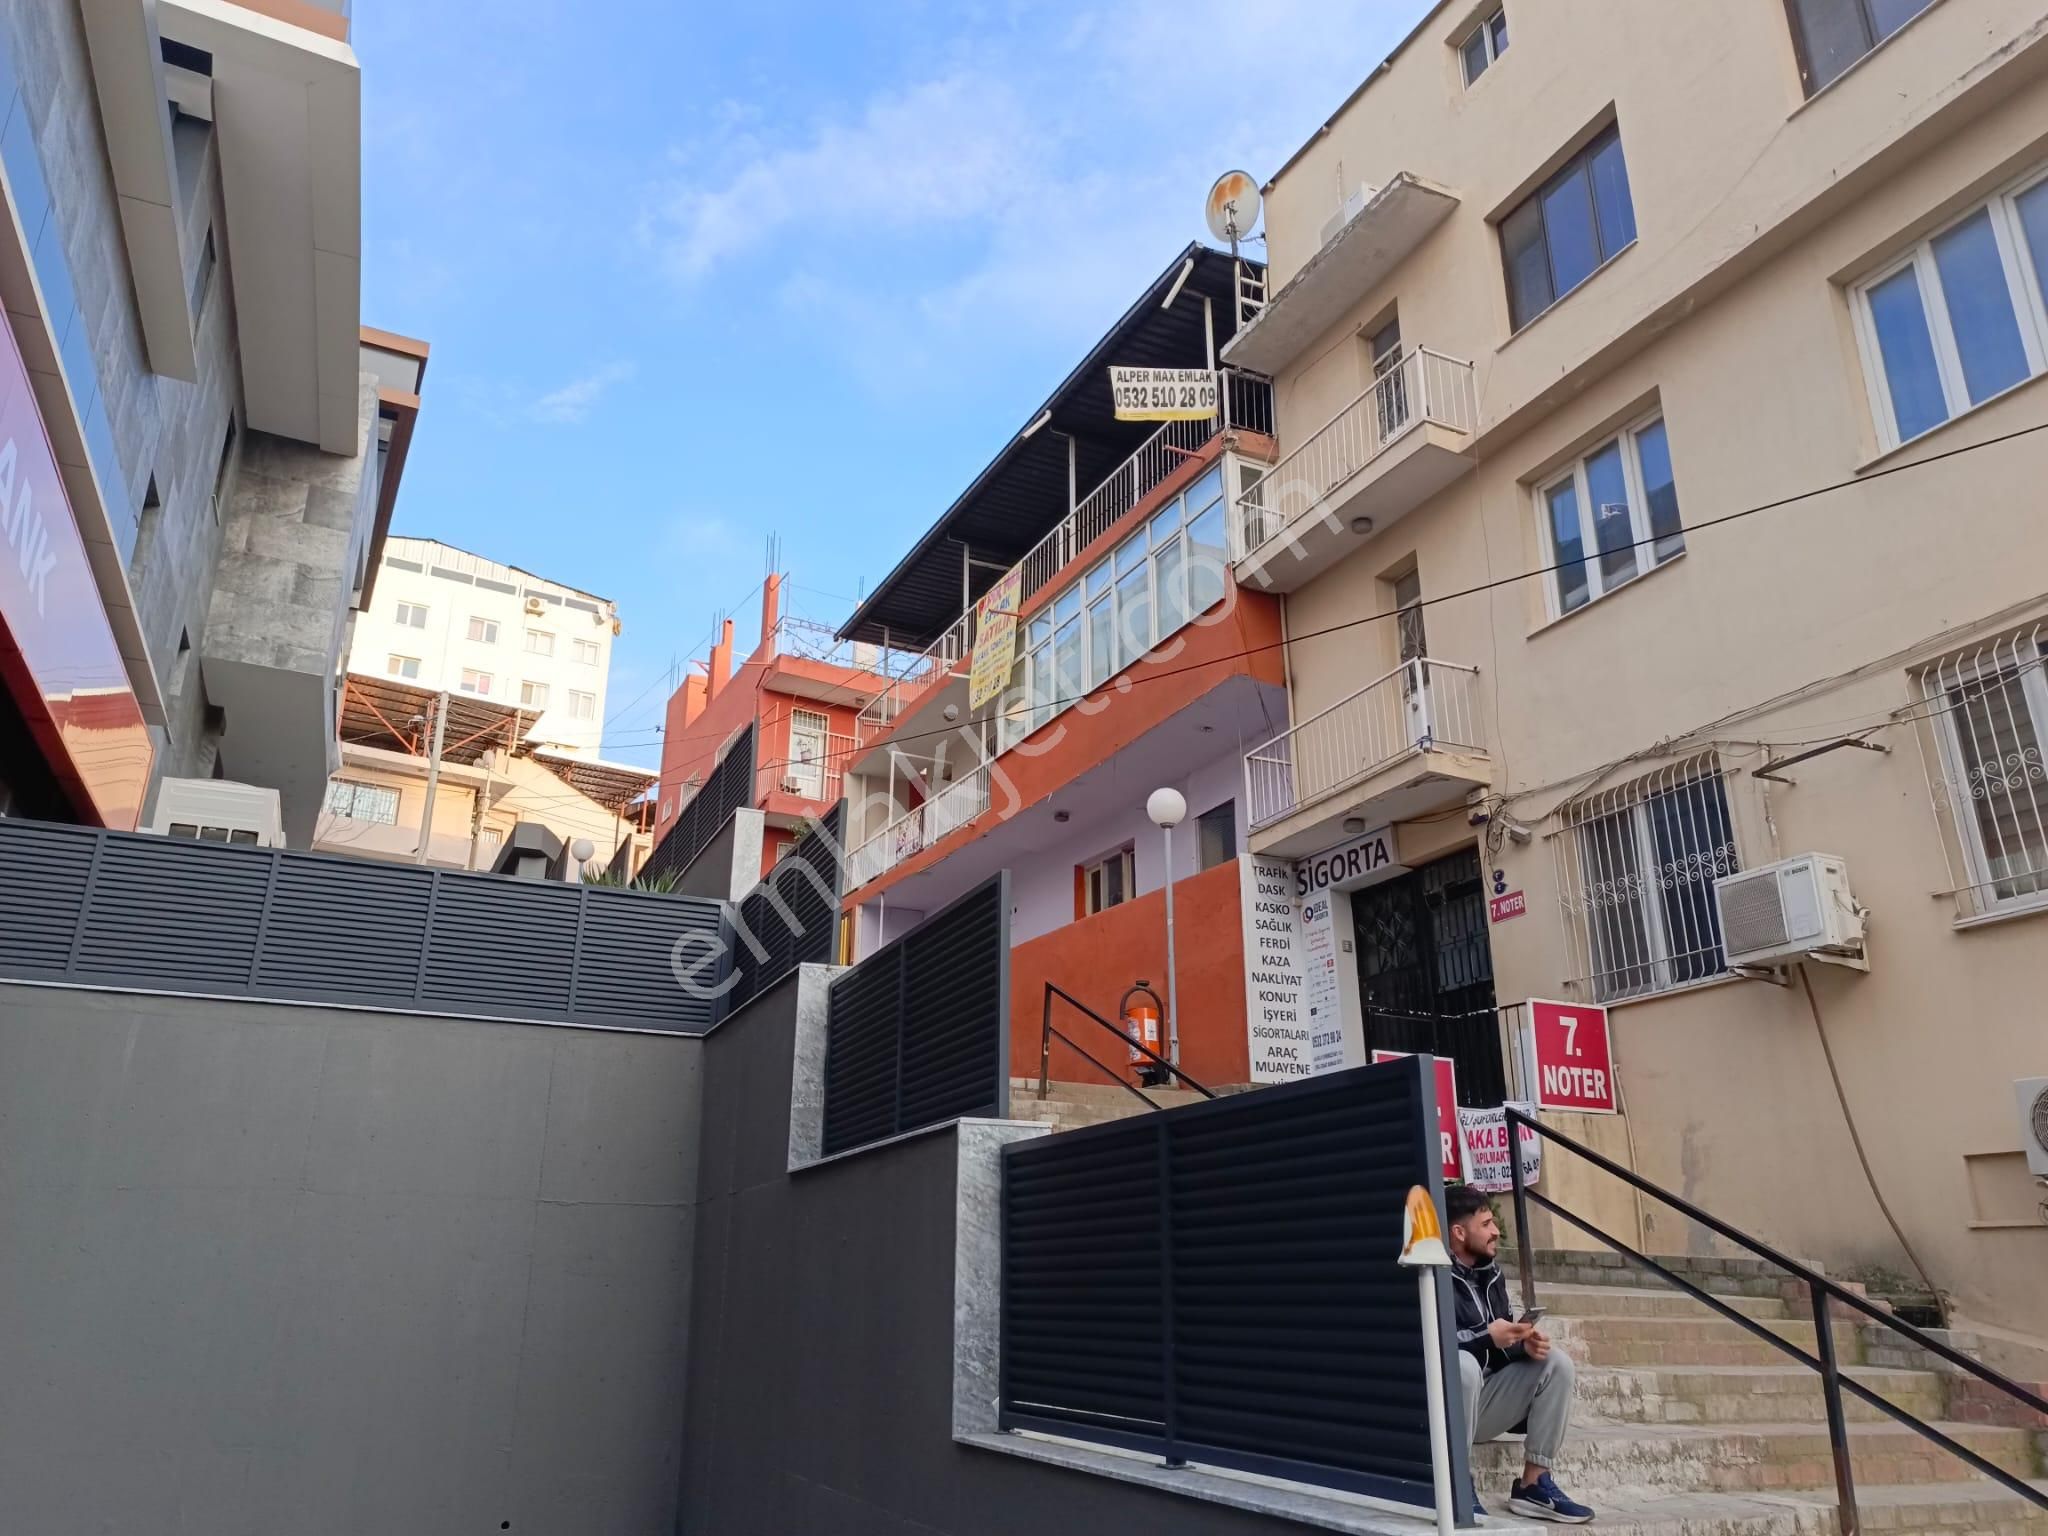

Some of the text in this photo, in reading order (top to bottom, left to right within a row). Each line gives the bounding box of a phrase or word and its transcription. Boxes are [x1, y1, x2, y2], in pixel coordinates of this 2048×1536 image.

[1117, 370, 1212, 383] ALPER MAX EMLAK
[1115, 386, 1216, 409] 0532 510 28 09
[1254, 865, 1289, 880] TRAFİK
[1297, 838, 1389, 896] SİGORTA
[1258, 883, 1286, 896] DASK
[1255, 902, 1290, 916] KASKO
[1500, 896, 1524, 914] NOTER
[1255, 918, 1292, 933] SAĞLIK
[1260, 937, 1290, 950] FERDİ
[1262, 954, 1291, 967] KAZA
[1252, 971, 1302, 987] NAKLİYAT
[1259, 991, 1298, 1004] KONUT
[1263, 1007, 1297, 1022] İŞYERİ
[1253, 1025, 1310, 1041] SİGORTALARI
[1559, 1016, 1582, 1056] 7.
[1268, 1046, 1298, 1060] ARAÇ
[1256, 1061, 1311, 1075] MUAYENE
[1543, 1065, 1607, 1099] NOTER
